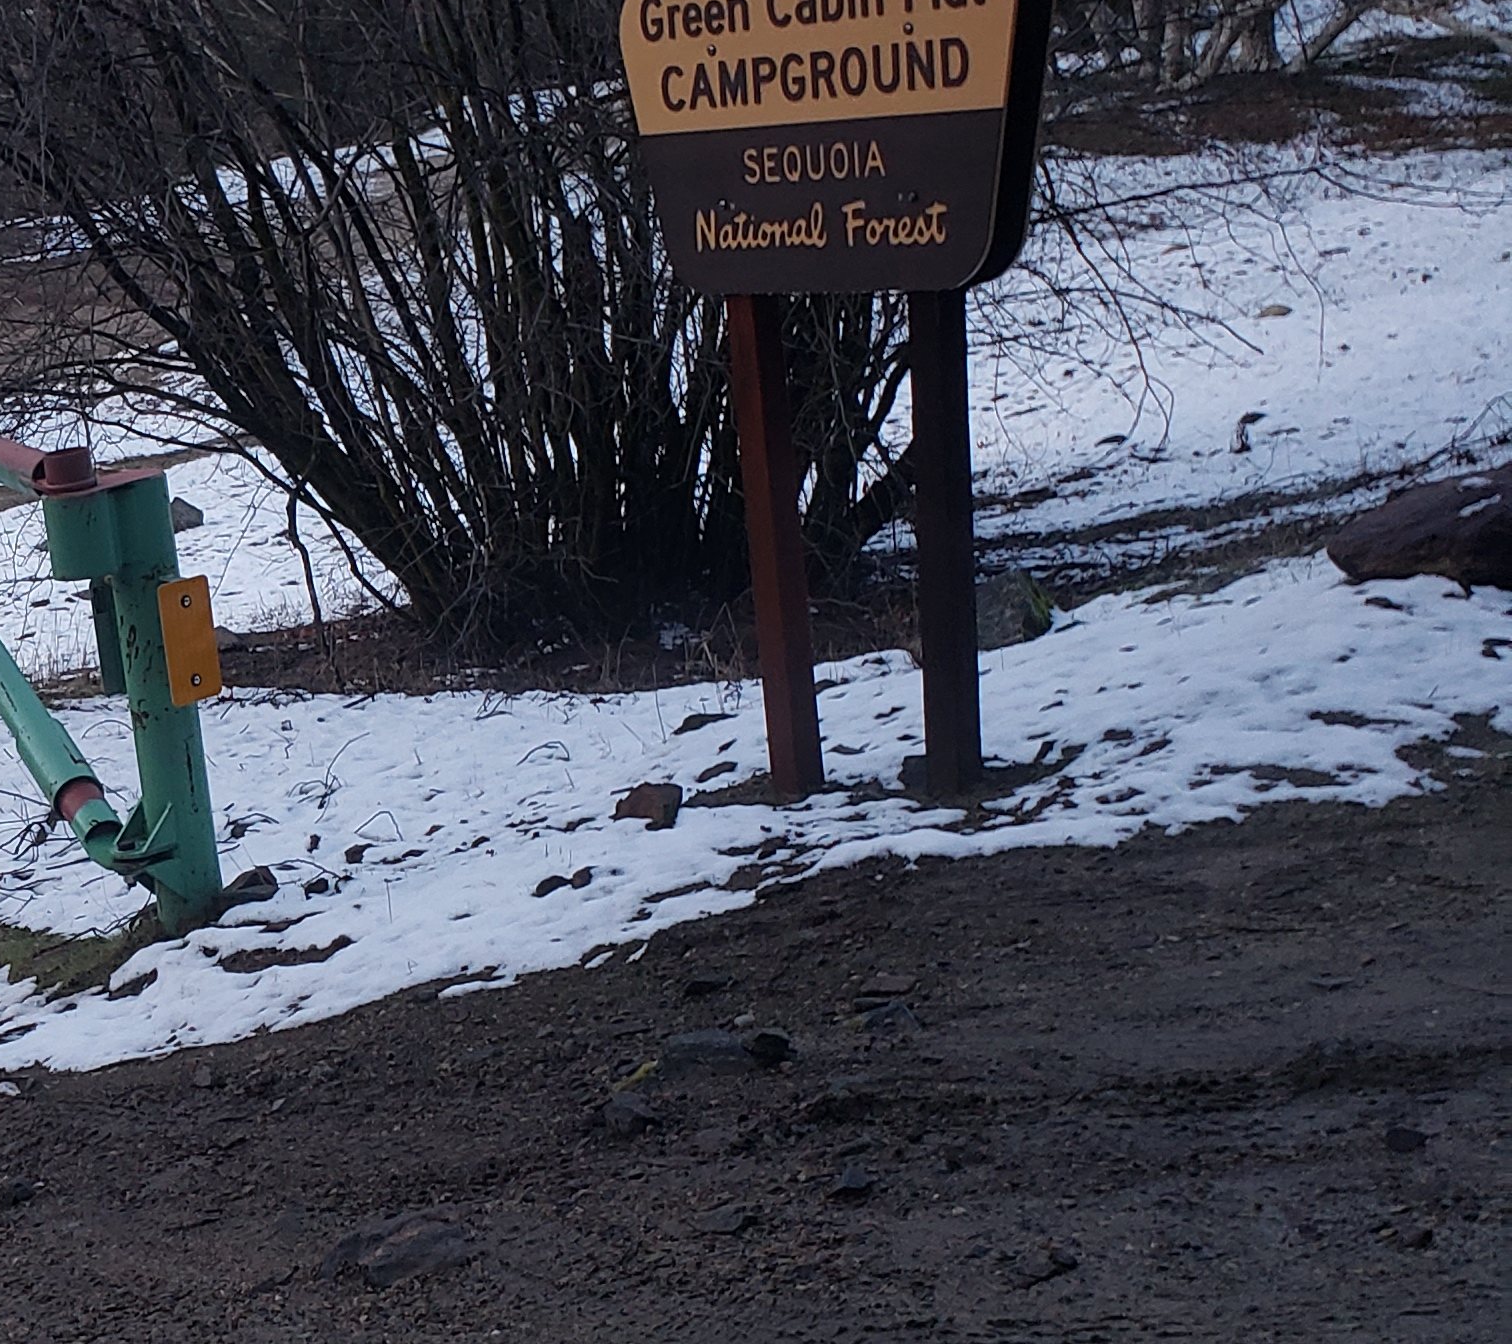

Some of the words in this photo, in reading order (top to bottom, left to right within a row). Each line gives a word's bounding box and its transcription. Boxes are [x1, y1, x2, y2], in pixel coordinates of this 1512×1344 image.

[661, 37, 969, 112] CAMPGROUND
[743, 140, 886, 184] SEQUOIA
[696, 202, 826, 252] National
[842, 201, 947, 246] Forest
